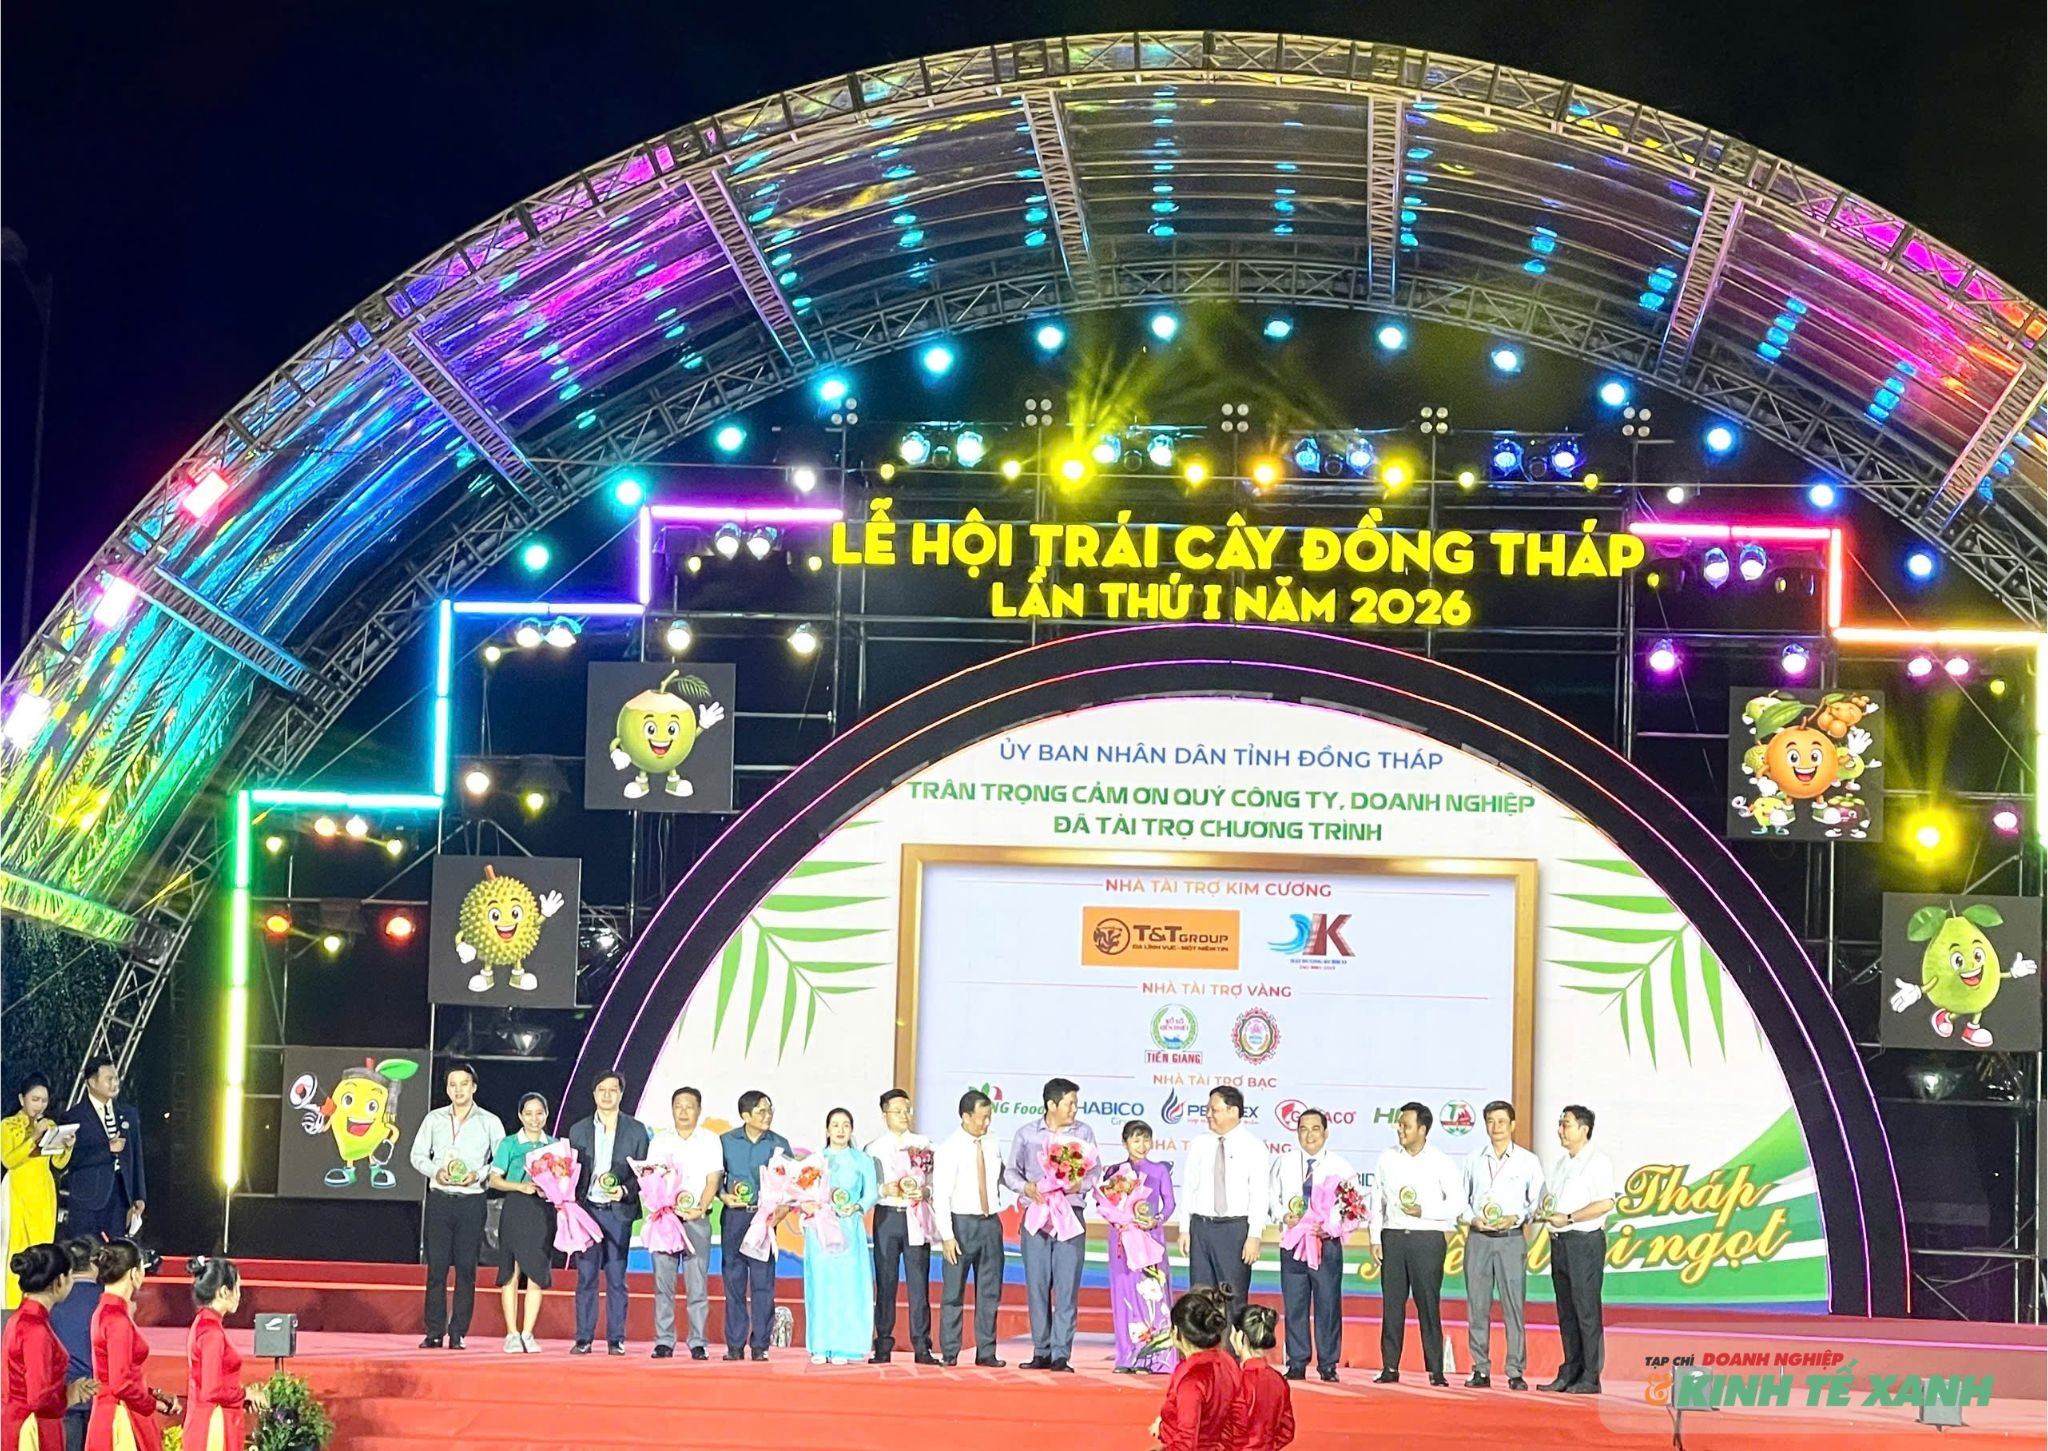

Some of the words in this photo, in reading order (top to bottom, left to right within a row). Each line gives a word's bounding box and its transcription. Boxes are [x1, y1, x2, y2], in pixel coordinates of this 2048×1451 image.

[832, 497, 896, 566] LỄ
[912, 507, 1013, 578] HỘI
[1029, 510, 1159, 568] TRÁI
[1174, 511, 1286, 571] CÂY
[1300, 507, 1475, 575] ĐỒNG
[1490, 518, 1646, 577] THÁP
[992, 566, 1085, 618] LẦN
[1099, 572, 1194, 620] THỨ
[1203, 585, 1222, 620] I
[1234, 576, 1337, 623] NĂM
[1349, 587, 1472, 626] 2026
[1000, 737, 1032, 761] ỦY
[1038, 744, 1088, 762] BAN
[1097, 743, 1166, 764] NHÂN
[1175, 744, 1227, 765] DÂN
[1233, 744, 1290, 767] TỈNH
[1297, 746, 1370, 768] ĐỒNG
[1377, 748, 1443, 770] THÁP
[907, 779, 976, 800] TRÂN
[982, 783, 1068, 805] TRỌNG
[1133, 786, 1169, 805] ƠN
[1173, 784, 1226, 807] QUÝ
[1231, 786, 1300, 808] CÔNG
[1305, 791, 1345, 811] TY,
[1351, 792, 1441, 811] DOANH
[1446, 792, 1536, 817] NGHIỆP
[1054, 814, 1091, 834] ĐÃ
[1096, 813, 1137, 836] TÀI
[1142, 817, 1195, 840] TRỢ
[1200, 819, 1303, 840] CHƯƠNG
[1308, 818, 1382, 841] TRÌNH
[1106, 877, 1145, 893] NHÀ
[1151, 879, 1178, 894] TÀI
[1183, 880, 1221, 897] TRỢ
[1226, 881, 1259, 896] KIM
[1265, 882, 1332, 898] CƯƠNG
[1133, 924, 1182, 943] T&T
[1179, 934, 1229, 944] GROUP
[1142, 980, 1176, 995] NHÀ
[1182, 981, 1206, 996] TÀI
[1211, 983, 1243, 999] TRỢ
[1247, 983, 1292, 998] VÀNG
[1172, 1053, 1201, 1064] GIANG
[1153, 1073, 1184, 1085] NHÀ
[1189, 1073, 1210, 1086] TÀI
[1247, 1077, 1277, 1091] BẠC
[1619, 1164, 1770, 1227] Tháp
[1644, 1208, 1792, 1285] ngọt
